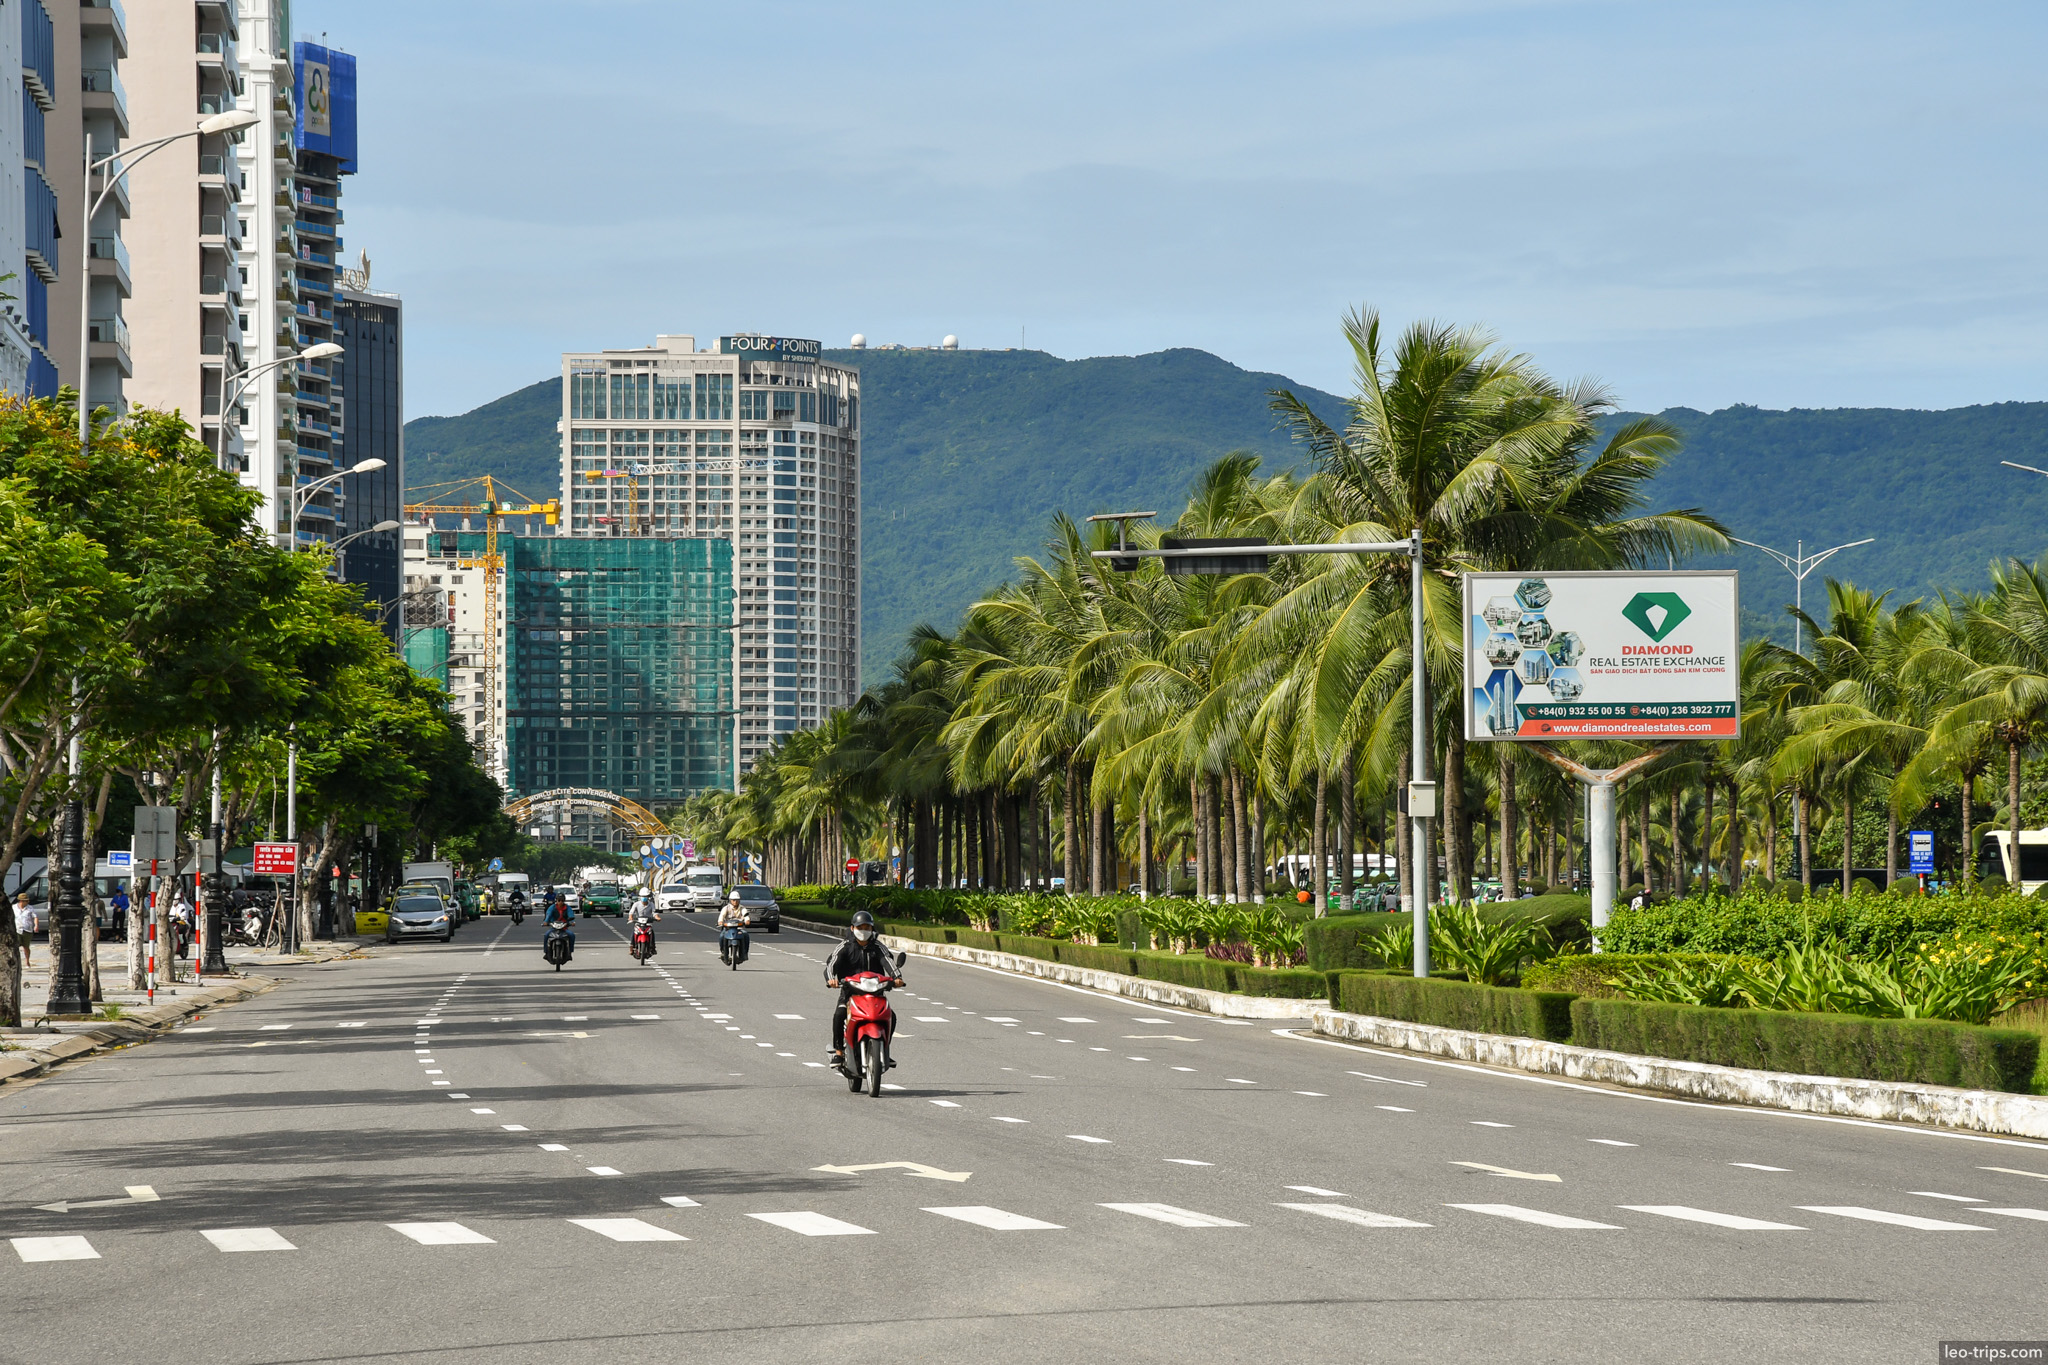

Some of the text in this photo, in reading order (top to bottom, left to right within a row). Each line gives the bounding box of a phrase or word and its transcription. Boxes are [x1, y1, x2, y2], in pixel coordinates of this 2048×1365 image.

[730, 337, 818, 354] FOUR POINTS
[1622, 645, 1693, 655] DIAMOND
[1590, 656, 1725, 667] REAL ESTATE EXCHANGE
[1538, 705, 1731, 717] +84(0) 932 55 00 55 +84(0) 236 3922 777
[1553, 722, 1712, 733] www.diamondrealestates.com
[528, 787, 621, 802] WORLD ELITE CONVERGENCE
[569, 799, 612, 810] CONVERGENCE
